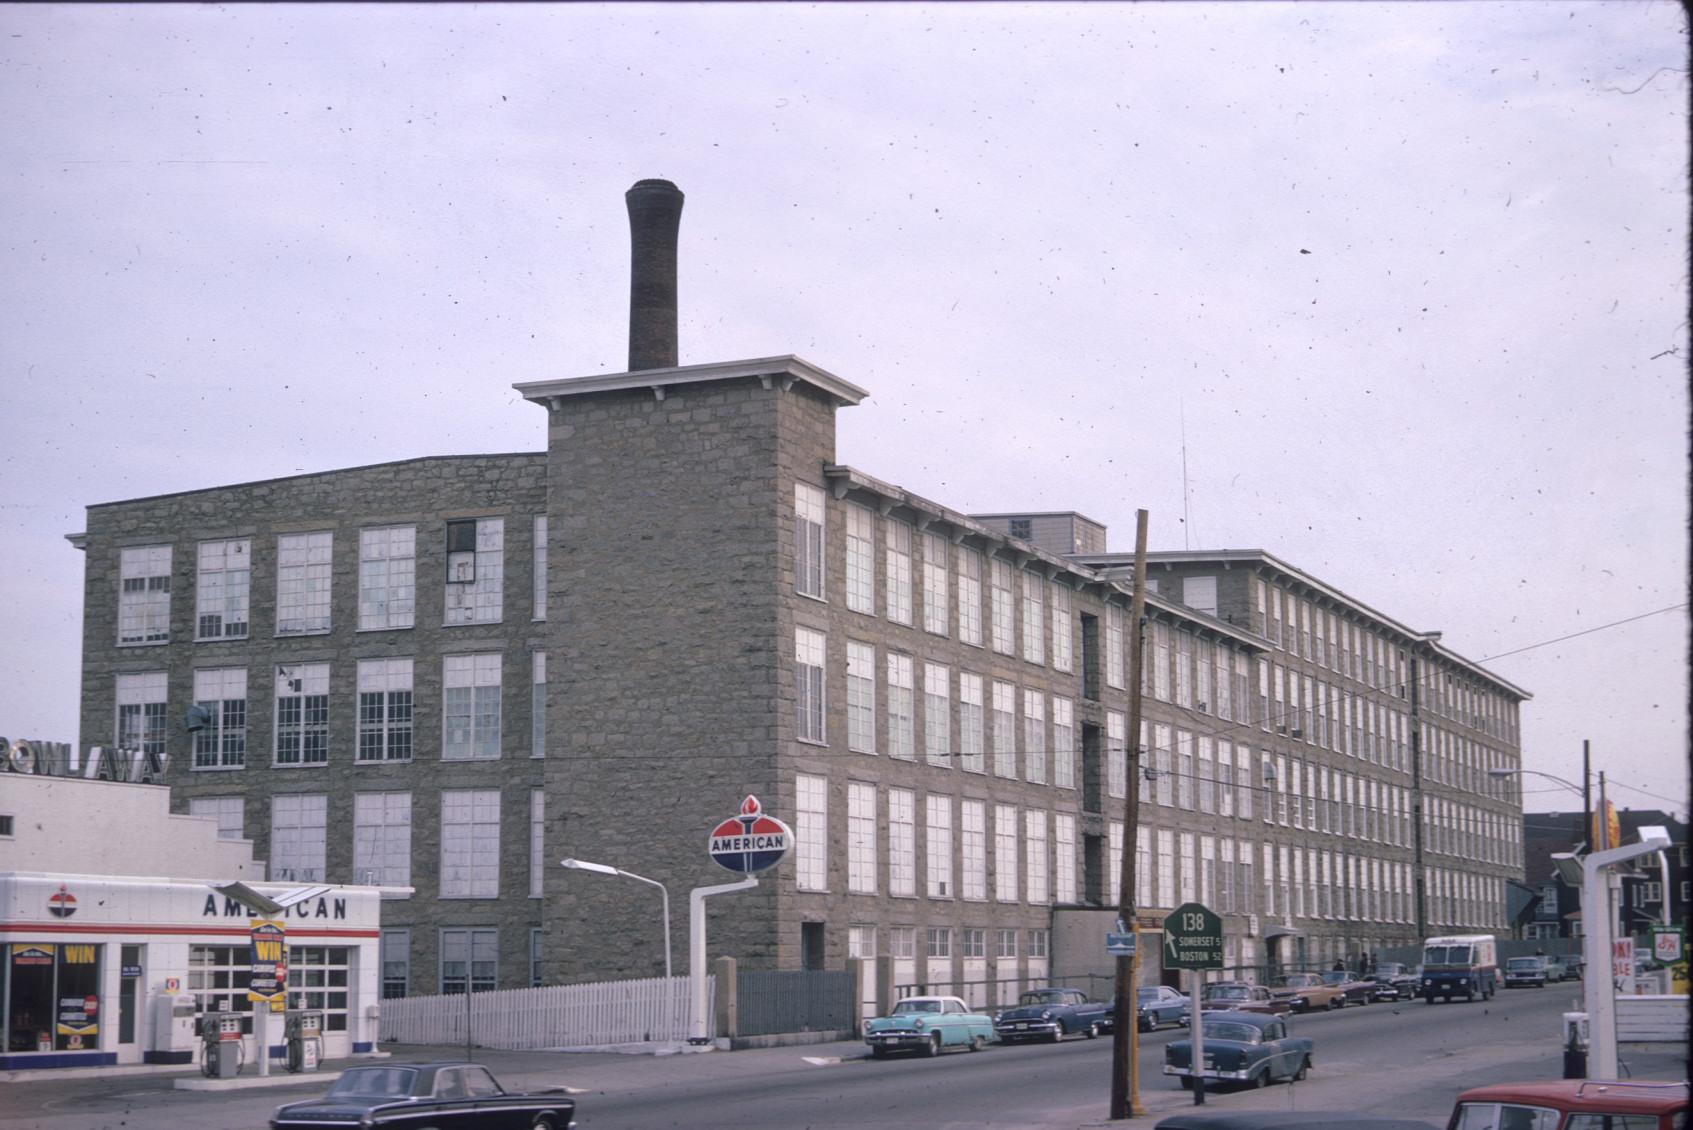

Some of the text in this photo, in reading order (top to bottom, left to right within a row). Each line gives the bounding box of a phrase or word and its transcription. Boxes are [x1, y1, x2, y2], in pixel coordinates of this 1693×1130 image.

[712, 837, 783, 851] AMERICAN
[1182, 913, 1204, 931] 138
[1179, 936, 1221, 946] SOMERSET 5
[64, 944, 95, 964] WIN
[256, 941, 281, 960] WIN
[1179, 951, 1222, 961] BOSTON 52
